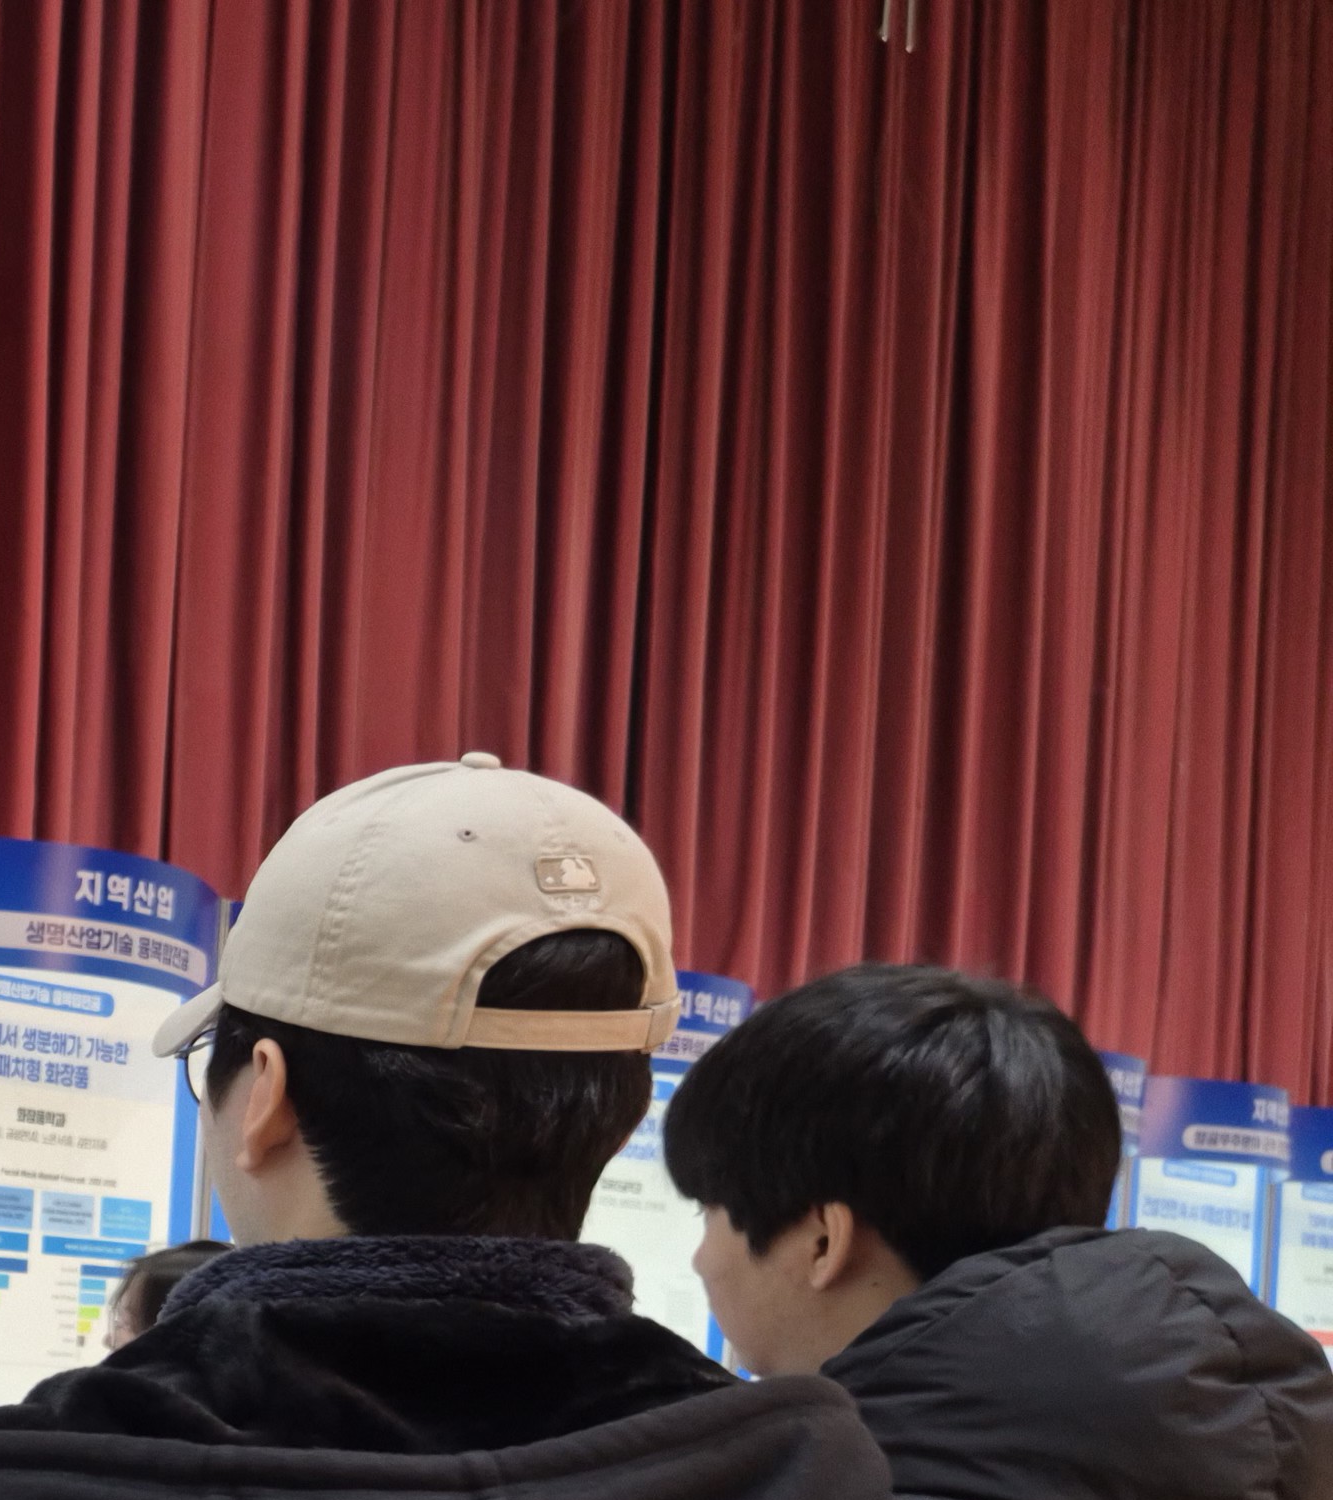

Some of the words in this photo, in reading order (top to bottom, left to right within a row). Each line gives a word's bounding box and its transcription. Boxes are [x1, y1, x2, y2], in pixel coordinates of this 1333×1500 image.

[74, 869, 175, 921] 지역산업
[26, 920, 133, 956] 생명산업기술
[22, 1025, 82, 1059] 생분해가
[86, 1033, 129, 1066] 가능한
